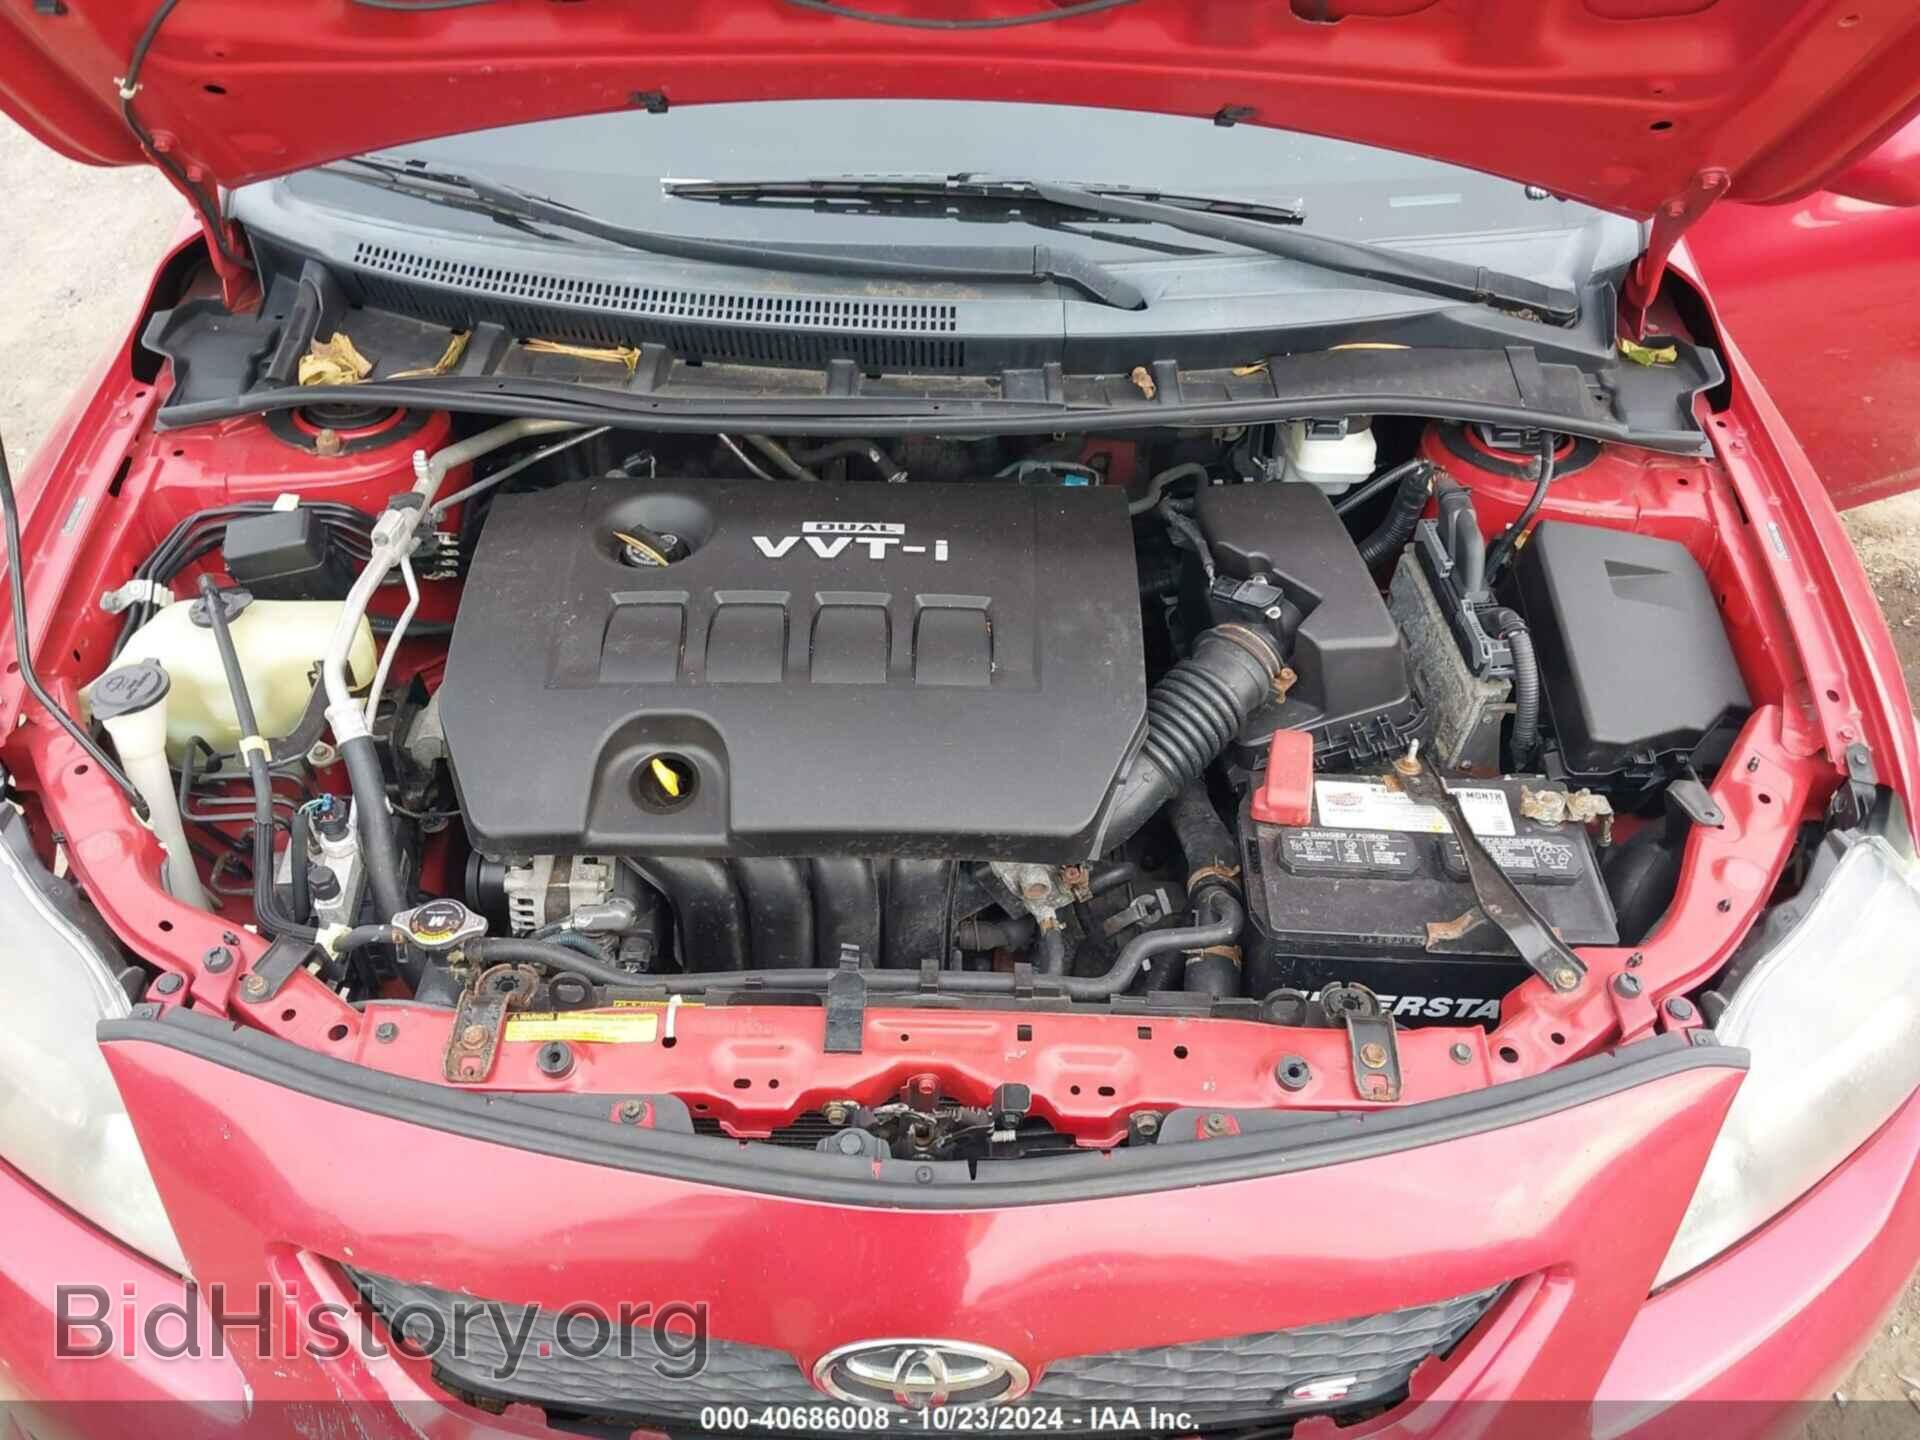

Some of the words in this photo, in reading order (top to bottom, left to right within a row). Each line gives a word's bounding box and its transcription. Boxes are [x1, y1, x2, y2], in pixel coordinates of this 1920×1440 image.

[816, 523, 896, 532] DUAL
[751, 536, 948, 561] VVT-i
[1311, 831, 1347, 840] DANGER
[1356, 832, 1389, 841] POISON
